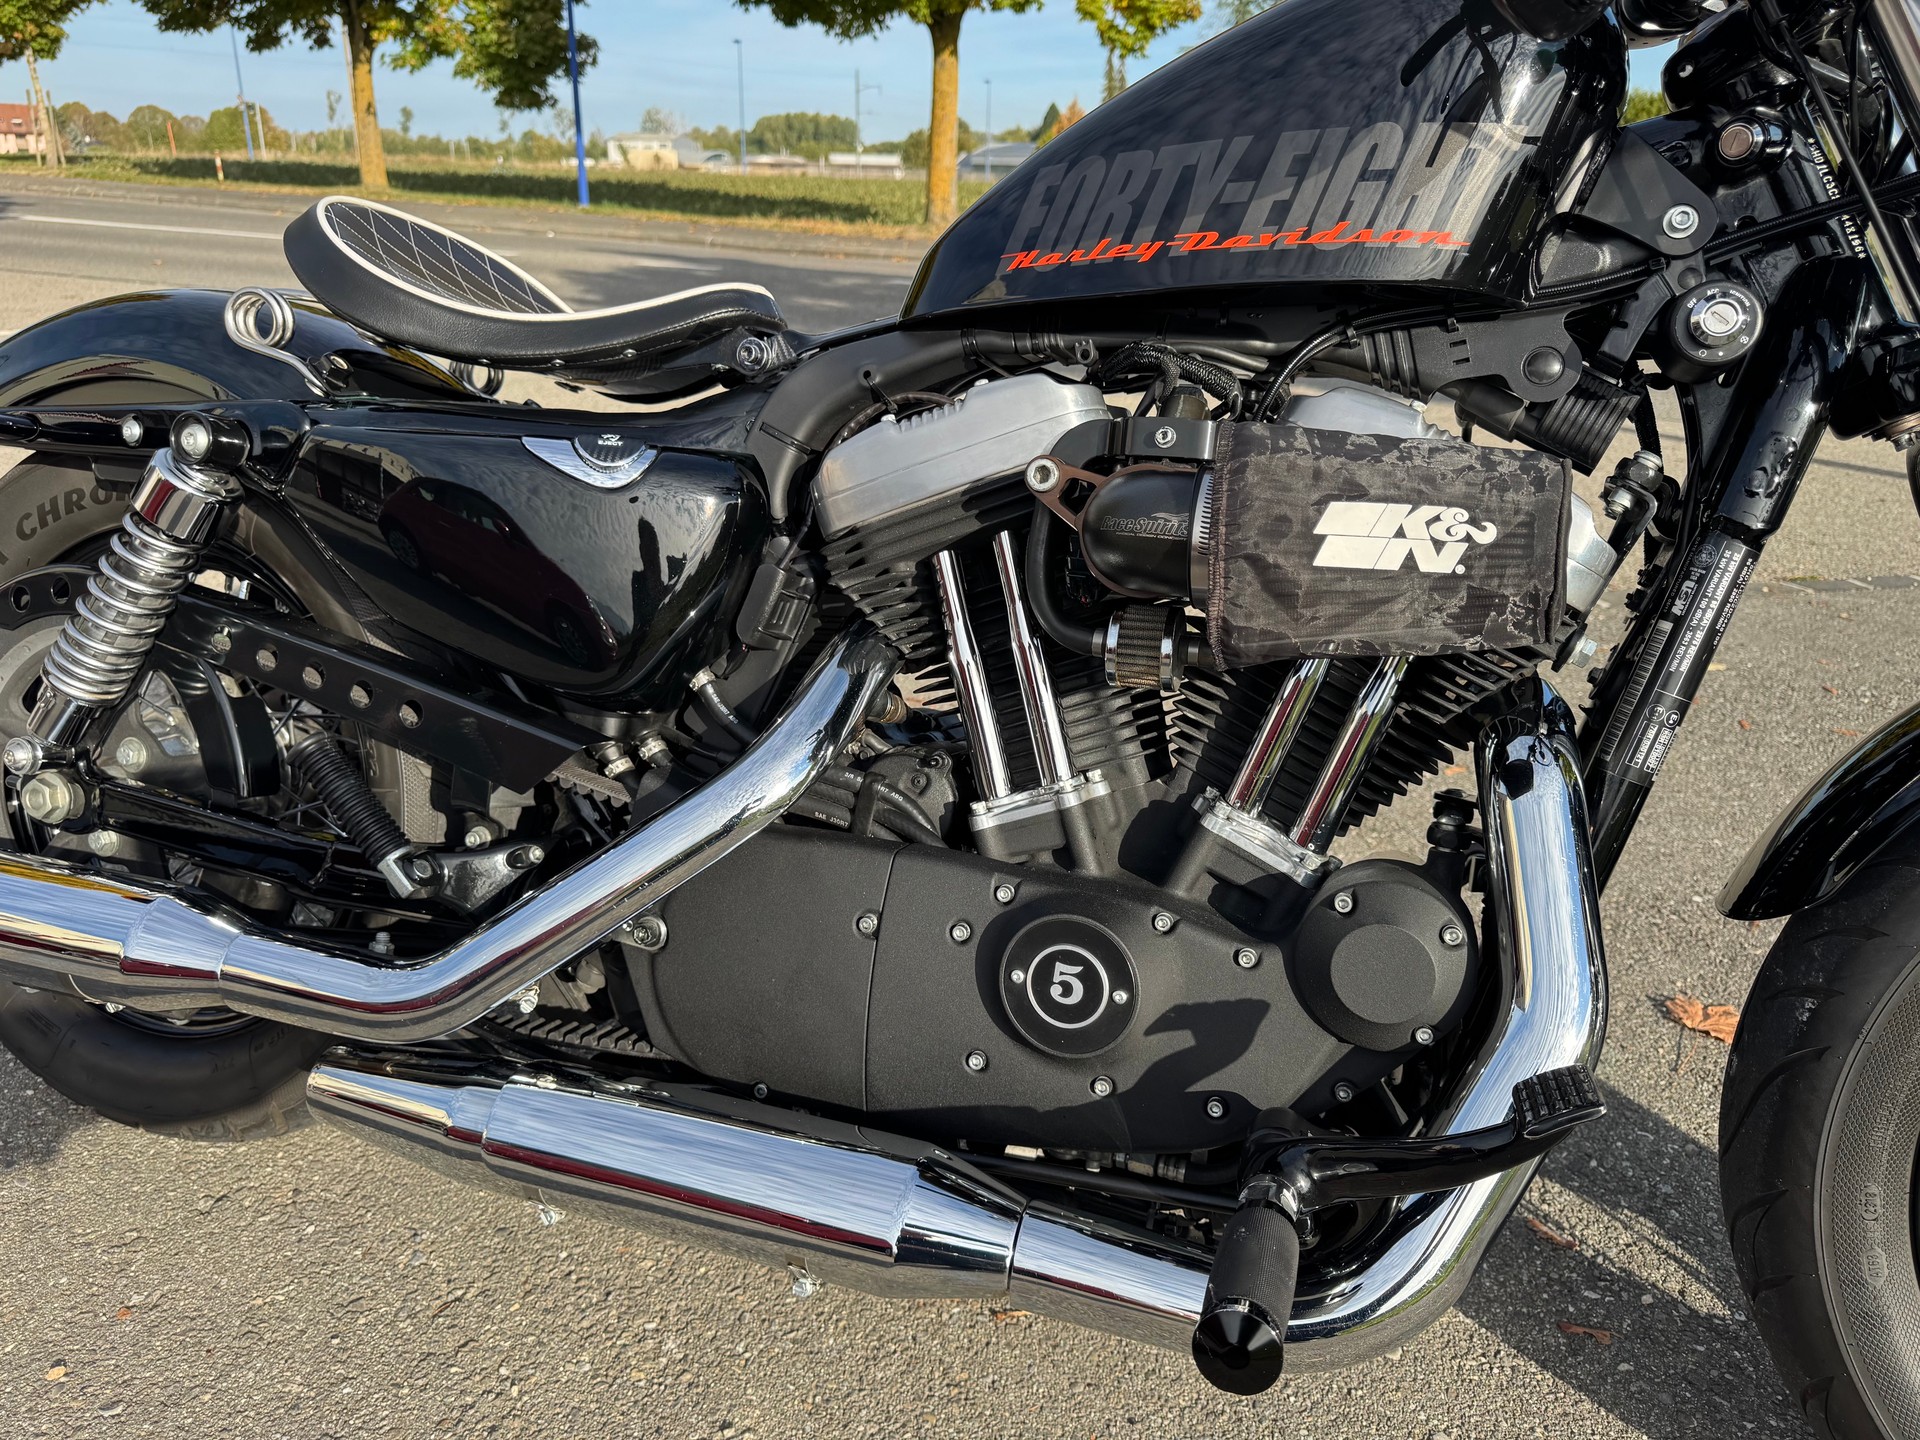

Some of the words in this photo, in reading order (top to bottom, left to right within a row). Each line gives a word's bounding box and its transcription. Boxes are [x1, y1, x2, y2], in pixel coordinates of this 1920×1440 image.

[997, 121, 1529, 276] FORTY-EIGHT
[1001, 221, 1470, 272] Harley-Davidson
[1687, 298, 1698, 309] OFF
[1706, 288, 1720, 296] ACC
[1729, 289, 1751, 307] IGNITION
[16, 478, 131, 541] CHRO
[1717, 556, 1728, 569] kW
[1704, 567, 1723, 597] VARIANT
[1713, 570, 1732, 600] VARIANT
[814, 811, 827, 821] SAE
[1050, 961, 1084, 1005] 5
